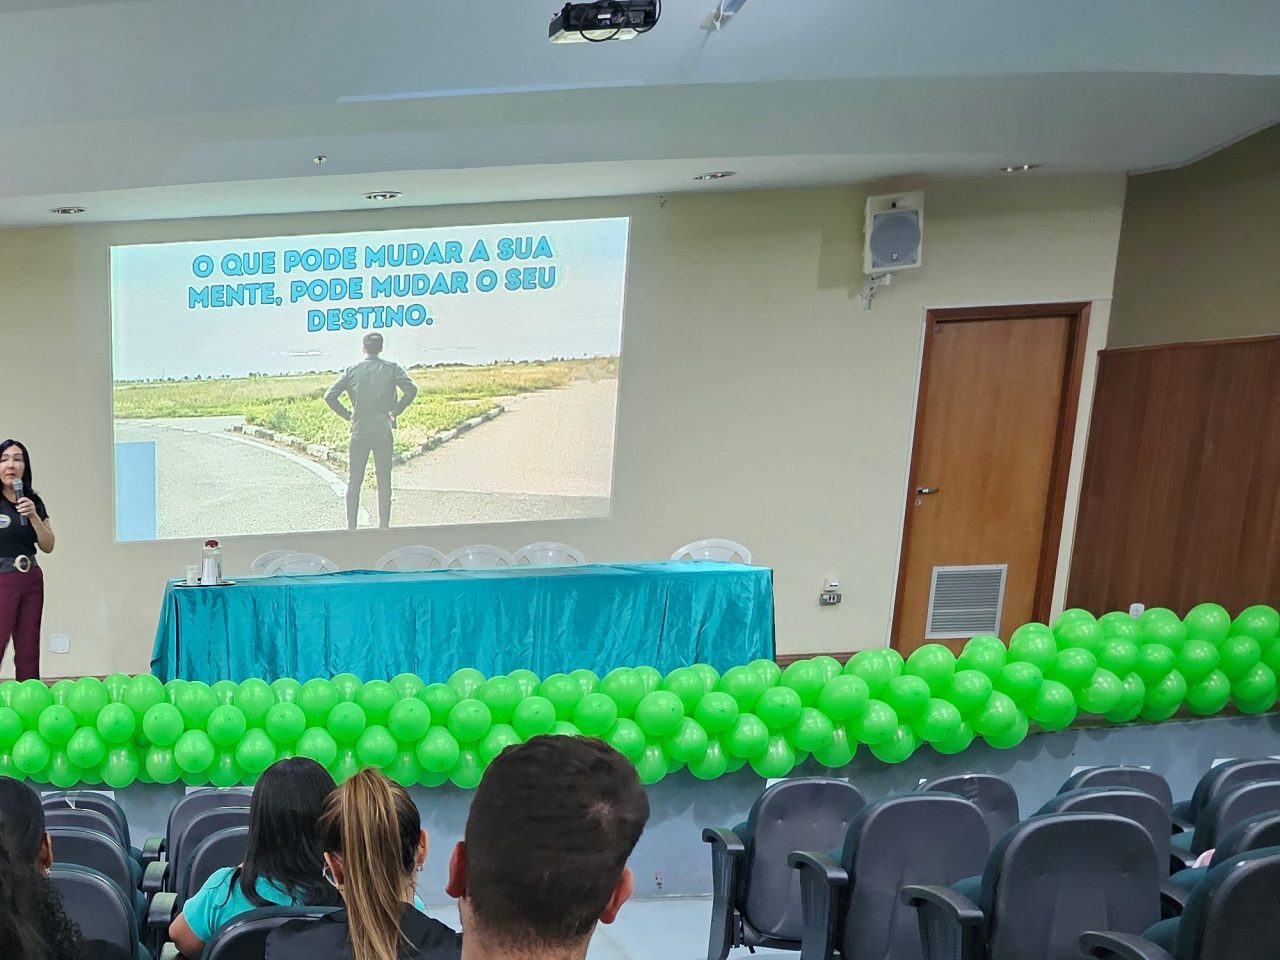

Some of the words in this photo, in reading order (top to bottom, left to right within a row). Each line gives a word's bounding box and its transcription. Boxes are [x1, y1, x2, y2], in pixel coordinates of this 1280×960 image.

[192, 254, 214, 278] O
[221, 252, 276, 277] QUE
[284, 246, 357, 273] PODE
[364, 240, 463, 268] MUDAR
[469, 239, 490, 263] A
[496, 235, 554, 261] SUA
[188, 281, 283, 309] MENTE,
[290, 277, 363, 303] PODE
[371, 271, 468, 299] MUDAR
[475, 269, 498, 292] O
[504, 266, 556, 291] SEU
[307, 303, 434, 332] DESTINO.
